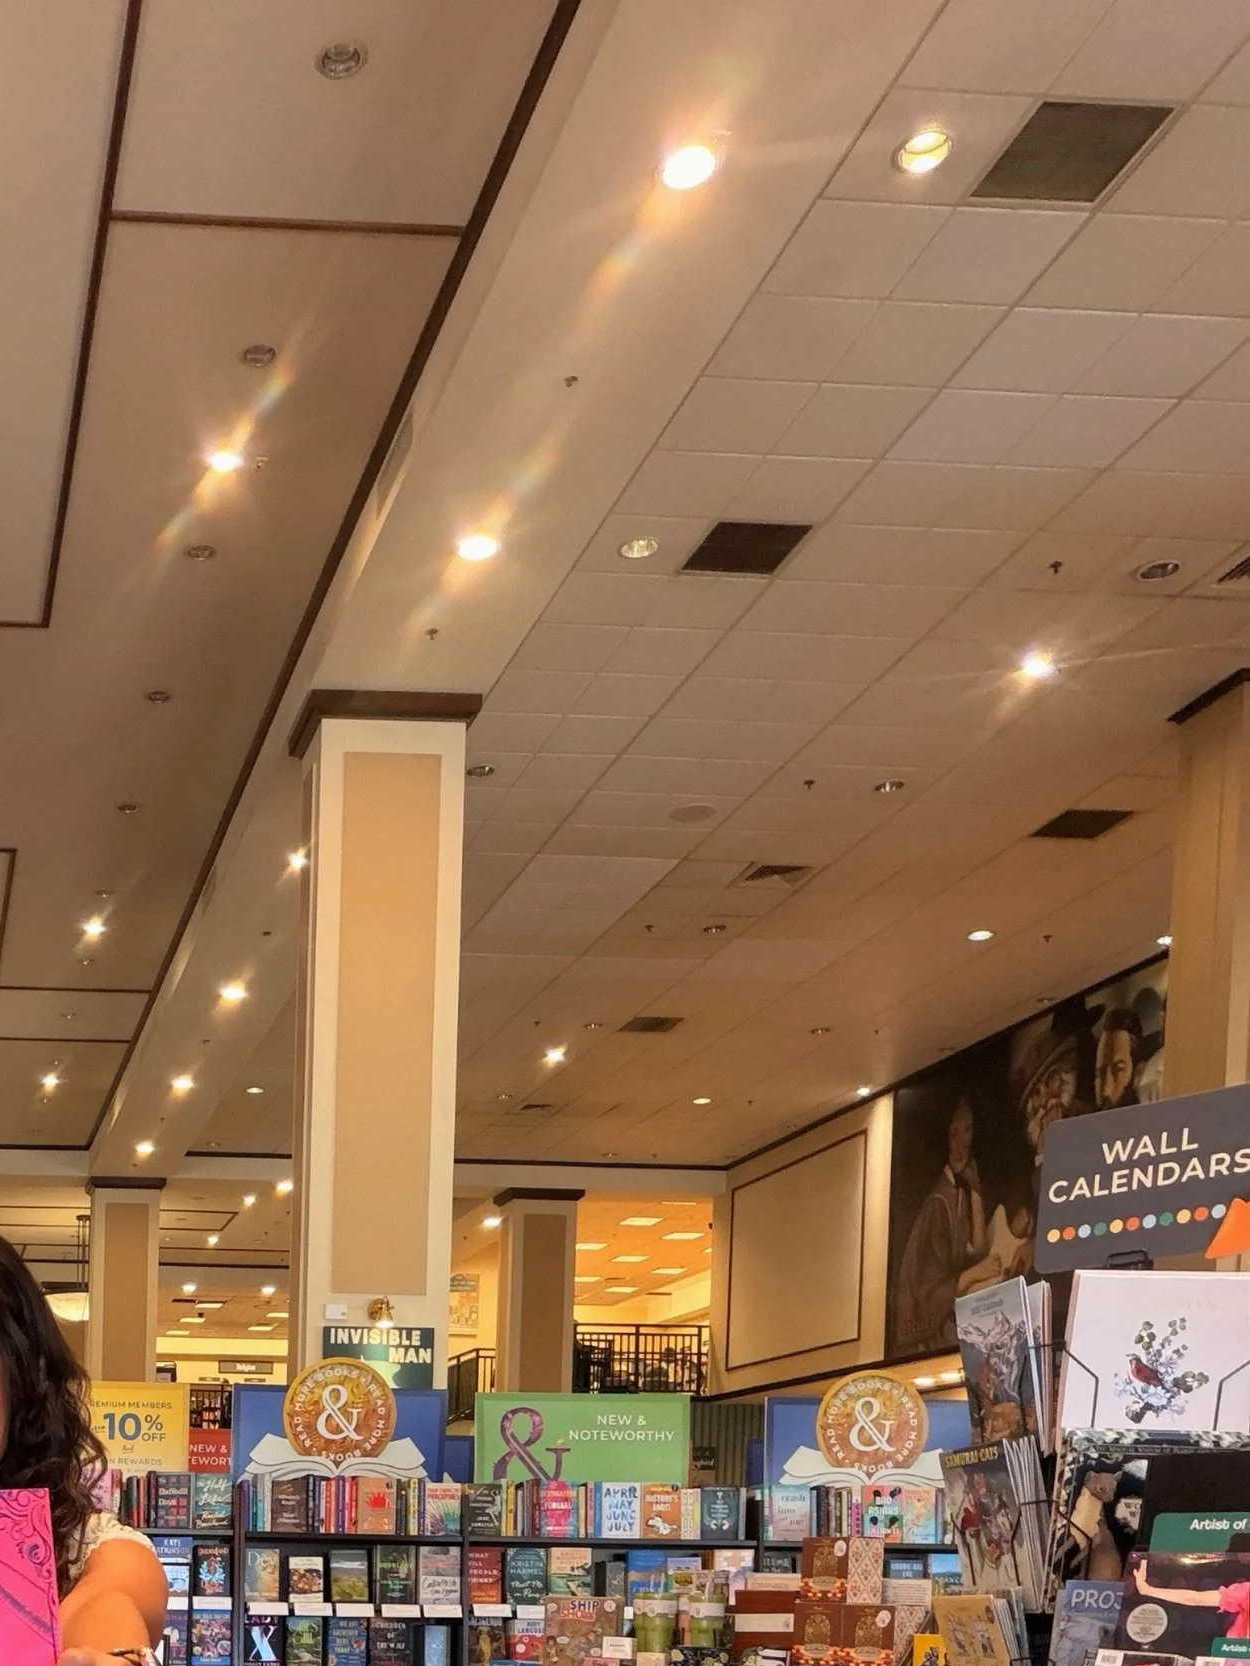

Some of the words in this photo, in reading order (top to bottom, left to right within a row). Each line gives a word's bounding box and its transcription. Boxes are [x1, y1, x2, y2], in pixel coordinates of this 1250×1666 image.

[1102, 1127, 1199, 1165] WALL
[1048, 1148, 1250, 1203] CALENDARS
[330, 1327, 421, 1346] INVISIBLE
[389, 1347, 431, 1363] MAN
[315, 1365, 360, 1382] BOOKS
[294, 1377, 315, 1411] MORE
[90, 1401, 126, 1409] REMIUM
[128, 1401, 172, 1409] MEMBERS
[316, 1384, 365, 1441] &
[103, 1412, 164, 1441] 10%
[597, 1414, 632, 1426] NEW
[637, 1414, 647, 1426] &
[849, 1396, 897, 1452] &
[141, 1432, 166, 1441] OFF
[294, 1417, 313, 1448] READ
[363, 1419, 385, 1451] MORE
[569, 1429, 675, 1442] NOTEWORTHY
[190, 1444, 216, 1453] NEW
[220, 1444, 227, 1453] &
[897, 1430, 918, 1463] MORE
[119, 1457, 163, 1465] REWARDS
[188, 1456, 232, 1466] TEWORT
[320, 1449, 362, 1462] BOOKS
[945, 1451, 978, 1468] SAMURAI
[981, 1447, 999, 1462] CATS
[853, 1460, 894, 1473] BOOKS
[158, 1487, 188, 1495] Daffodil
[875, 1496, 891, 1505] BAD
[607, 1510, 635, 1520] JUNE
[868, 1506, 899, 1515] ASIANS
[607, 1521, 635, 1532] JULY
[1190, 1519, 1230, 1531] Artist
[1233, 1518, 1247, 1531] of
[571, 1600, 599, 1610] SHIP
[1071, 1588, 1125, 1610] PROJ
[1222, 1643, 1247, 1652] Artist
